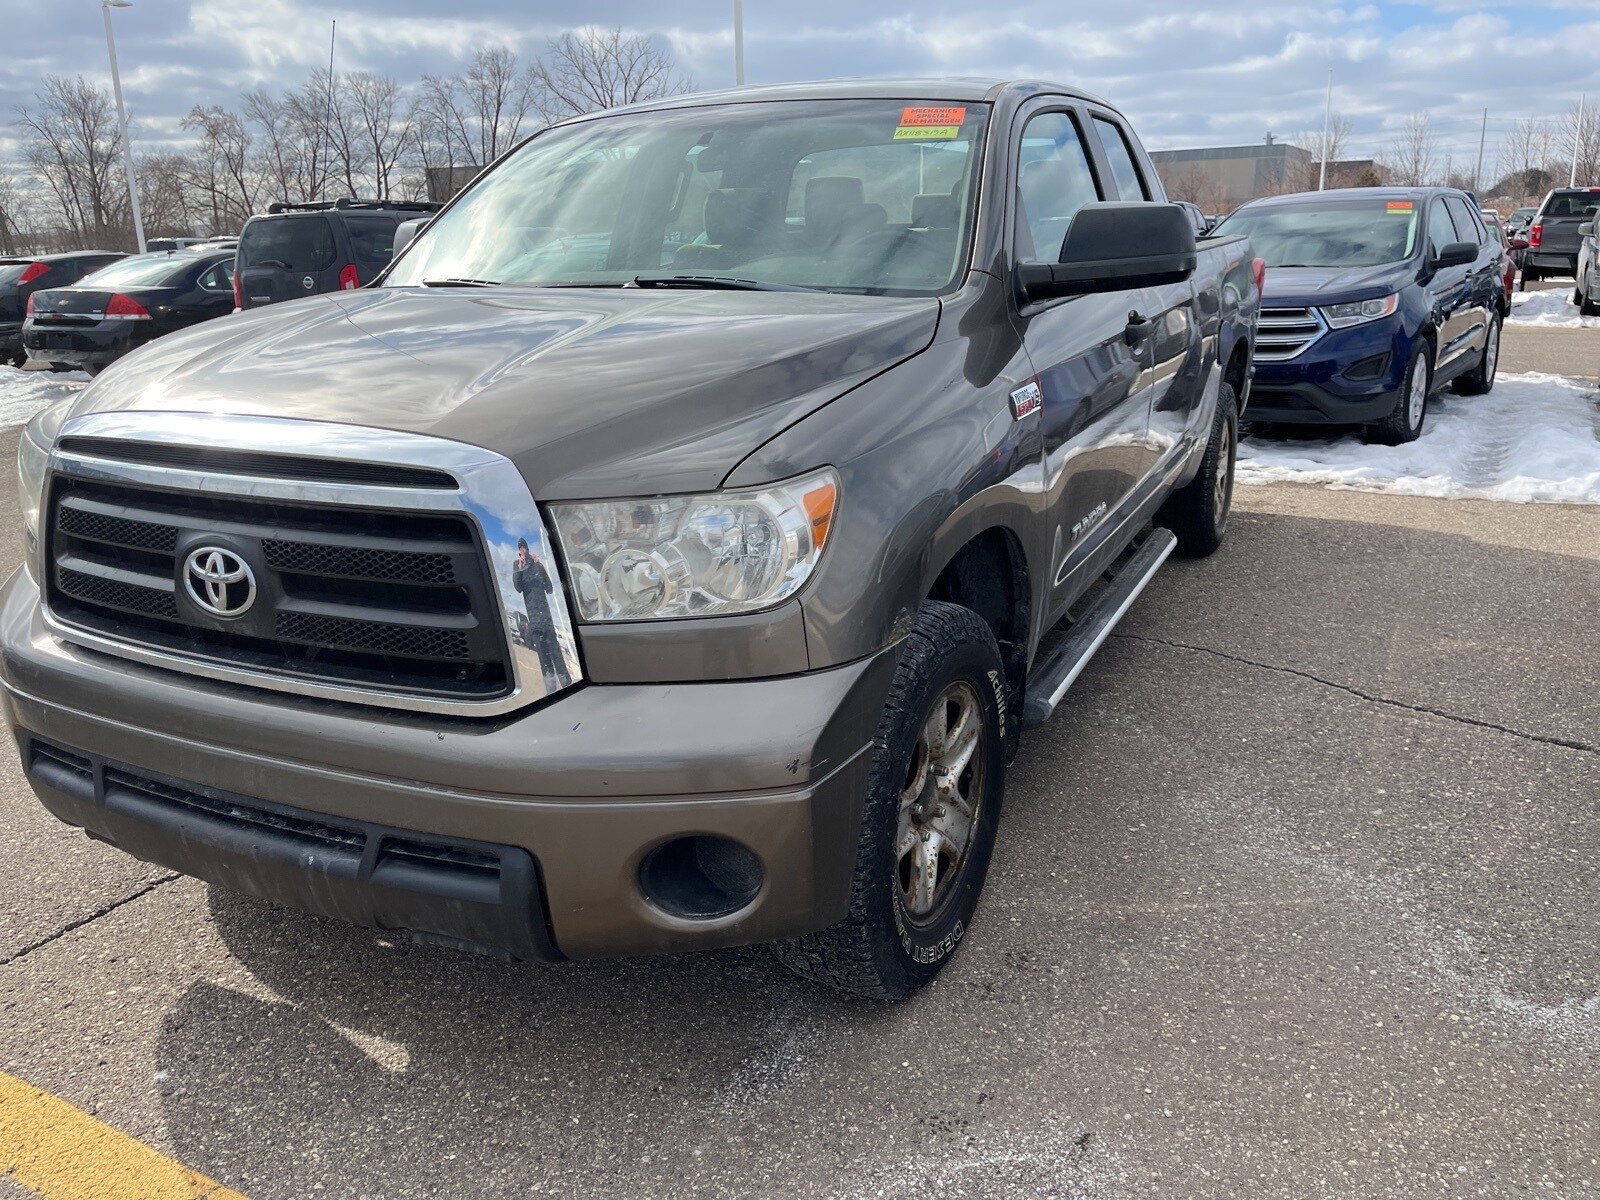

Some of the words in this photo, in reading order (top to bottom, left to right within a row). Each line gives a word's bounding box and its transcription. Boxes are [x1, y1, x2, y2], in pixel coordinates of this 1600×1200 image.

[1070, 501, 1107, 540] TUNDRA
[987, 670, 1006, 737] Achilles
[912, 920, 965, 964] DESERT
